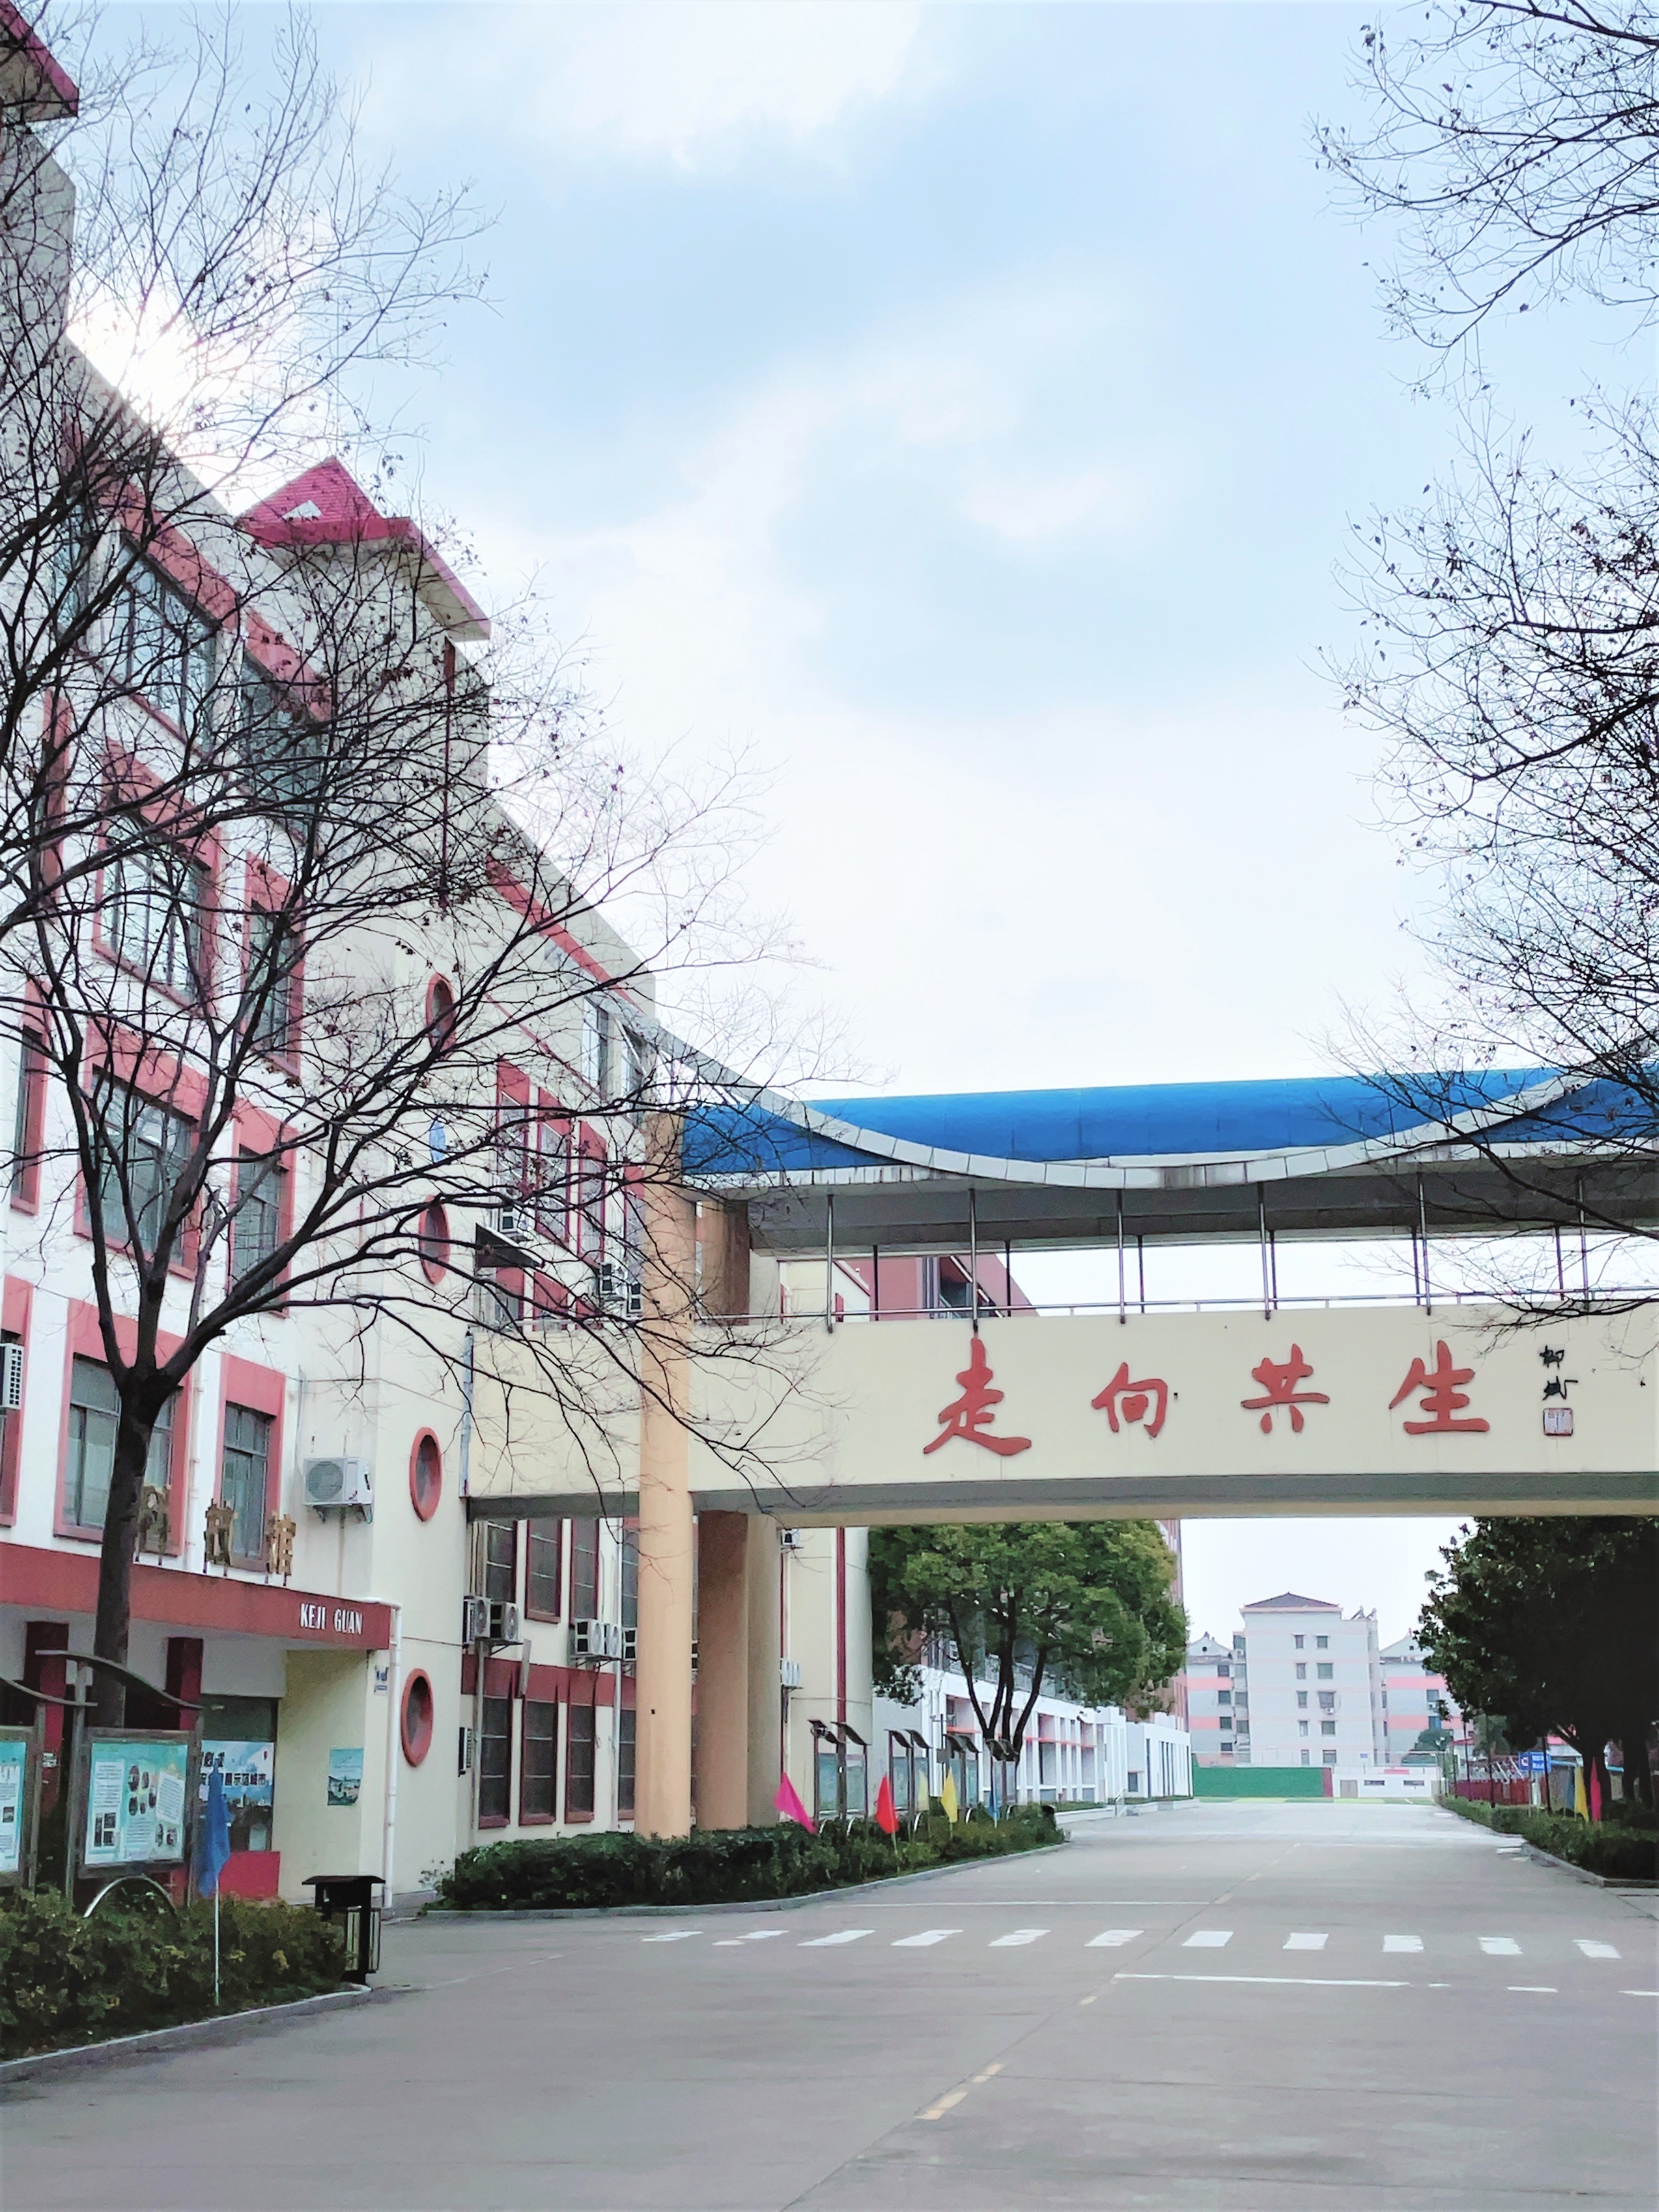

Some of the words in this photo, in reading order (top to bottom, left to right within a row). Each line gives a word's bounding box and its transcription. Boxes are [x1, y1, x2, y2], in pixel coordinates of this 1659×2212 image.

[923, 1337, 1491, 1456] 走向共生
[300, 1602, 326, 1630] KEJI
[334, 1608, 363, 1635] GUAN
